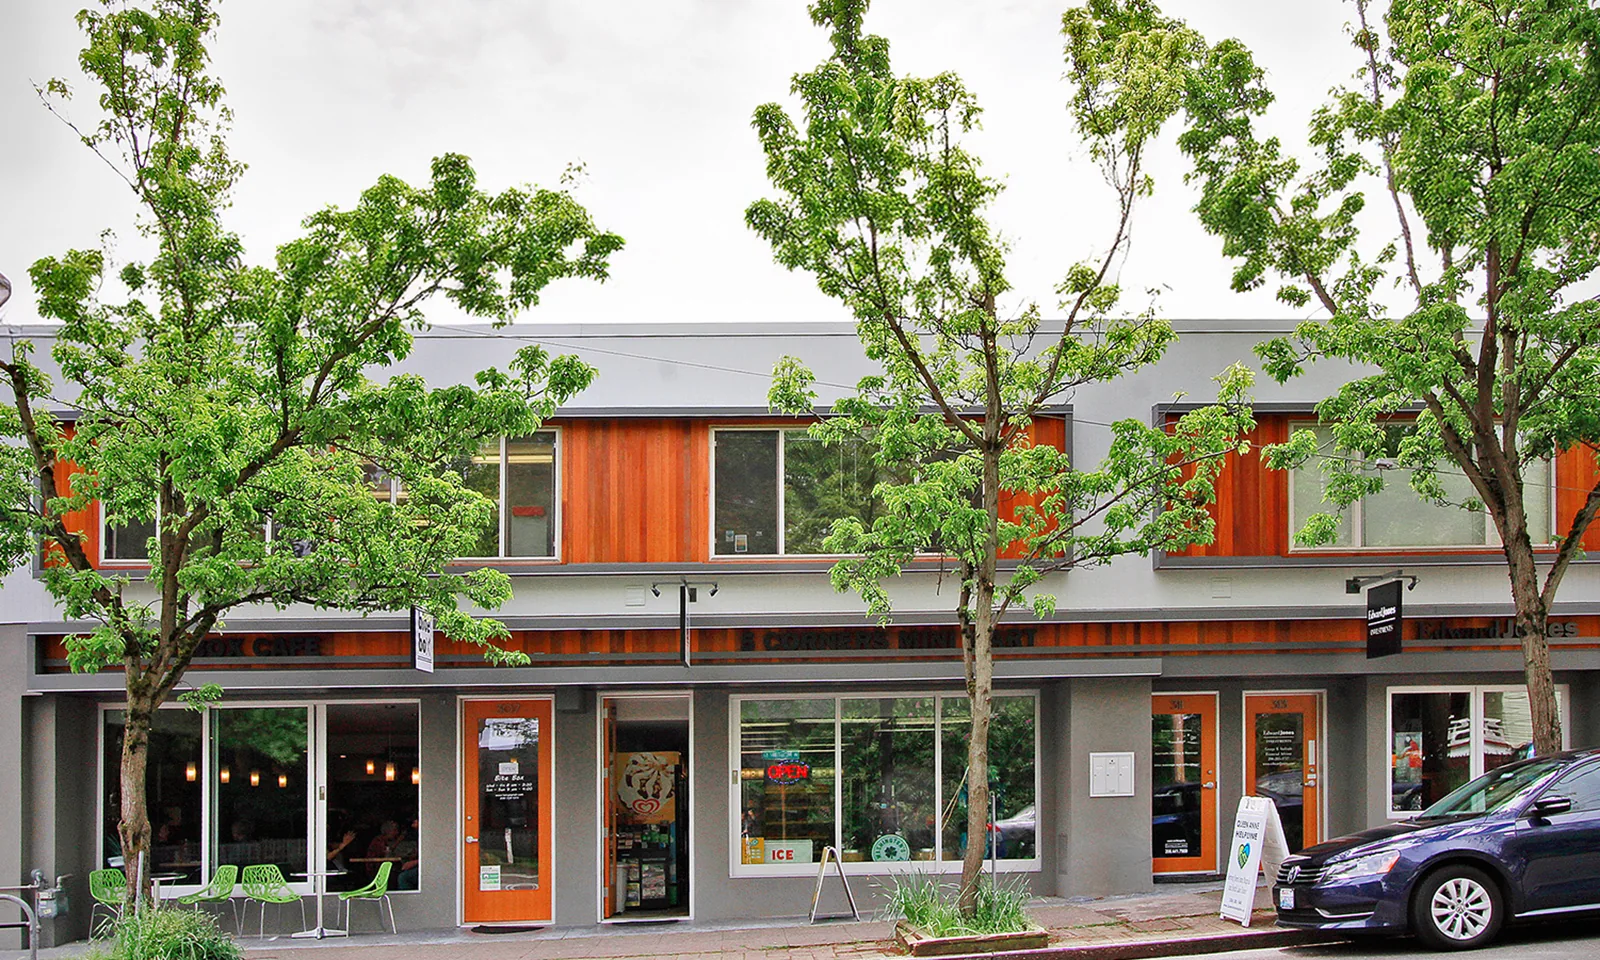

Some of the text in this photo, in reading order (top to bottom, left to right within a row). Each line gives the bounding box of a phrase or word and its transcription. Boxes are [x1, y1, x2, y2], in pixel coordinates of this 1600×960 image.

[252, 637, 320, 656] CAFE
[763, 631, 888, 650] CORNERS
[899, 631, 957, 649] MINI
[970, 628, 1037, 648] ART
[767, 764, 809, 779] OPEN
[772, 850, 794, 861] ICE
